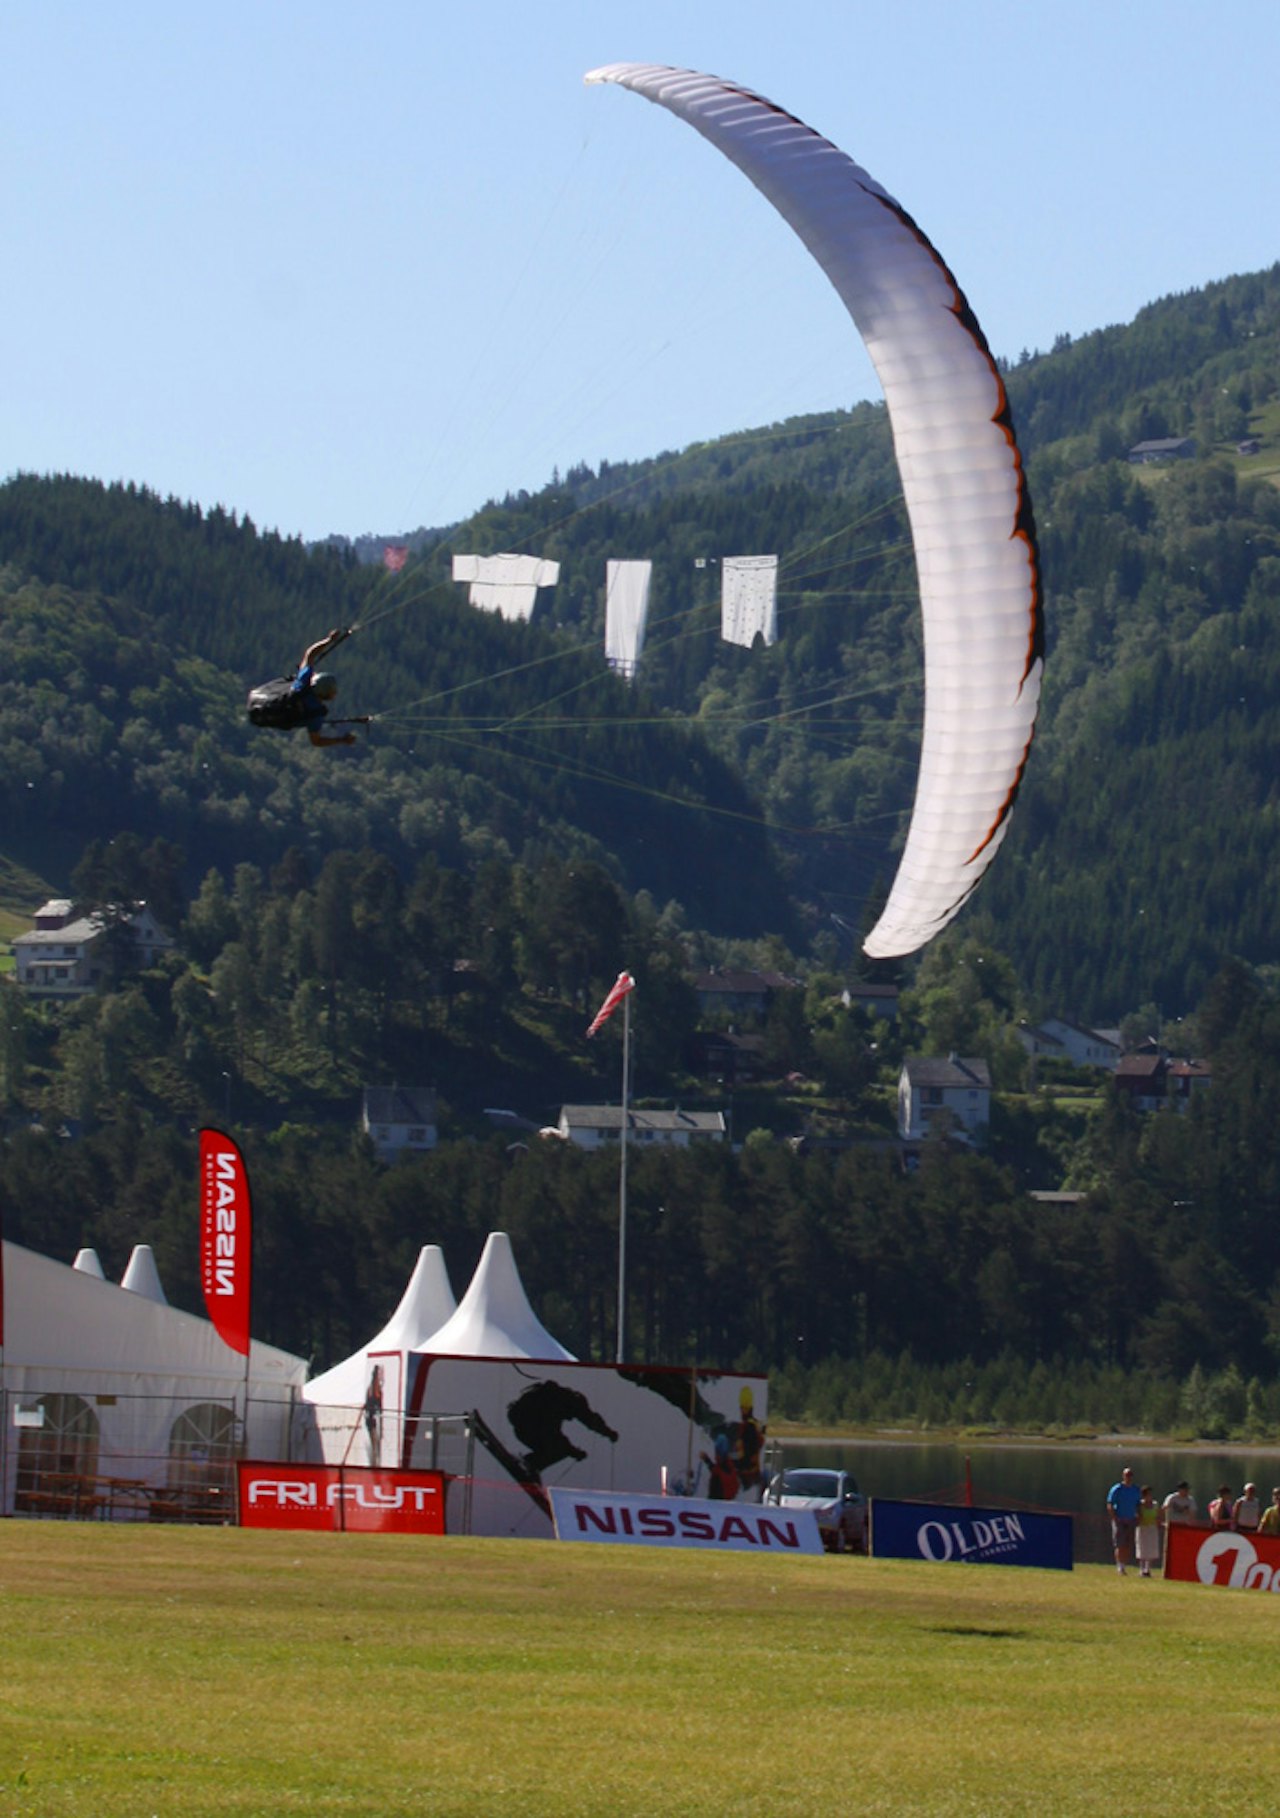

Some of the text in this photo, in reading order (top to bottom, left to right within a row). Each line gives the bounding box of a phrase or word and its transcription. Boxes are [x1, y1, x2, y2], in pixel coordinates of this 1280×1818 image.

[248, 1480, 436, 1511] FRI FLYT
[574, 1504, 801, 1548] NISSAN
[917, 1514, 1026, 1562] OLDEN
